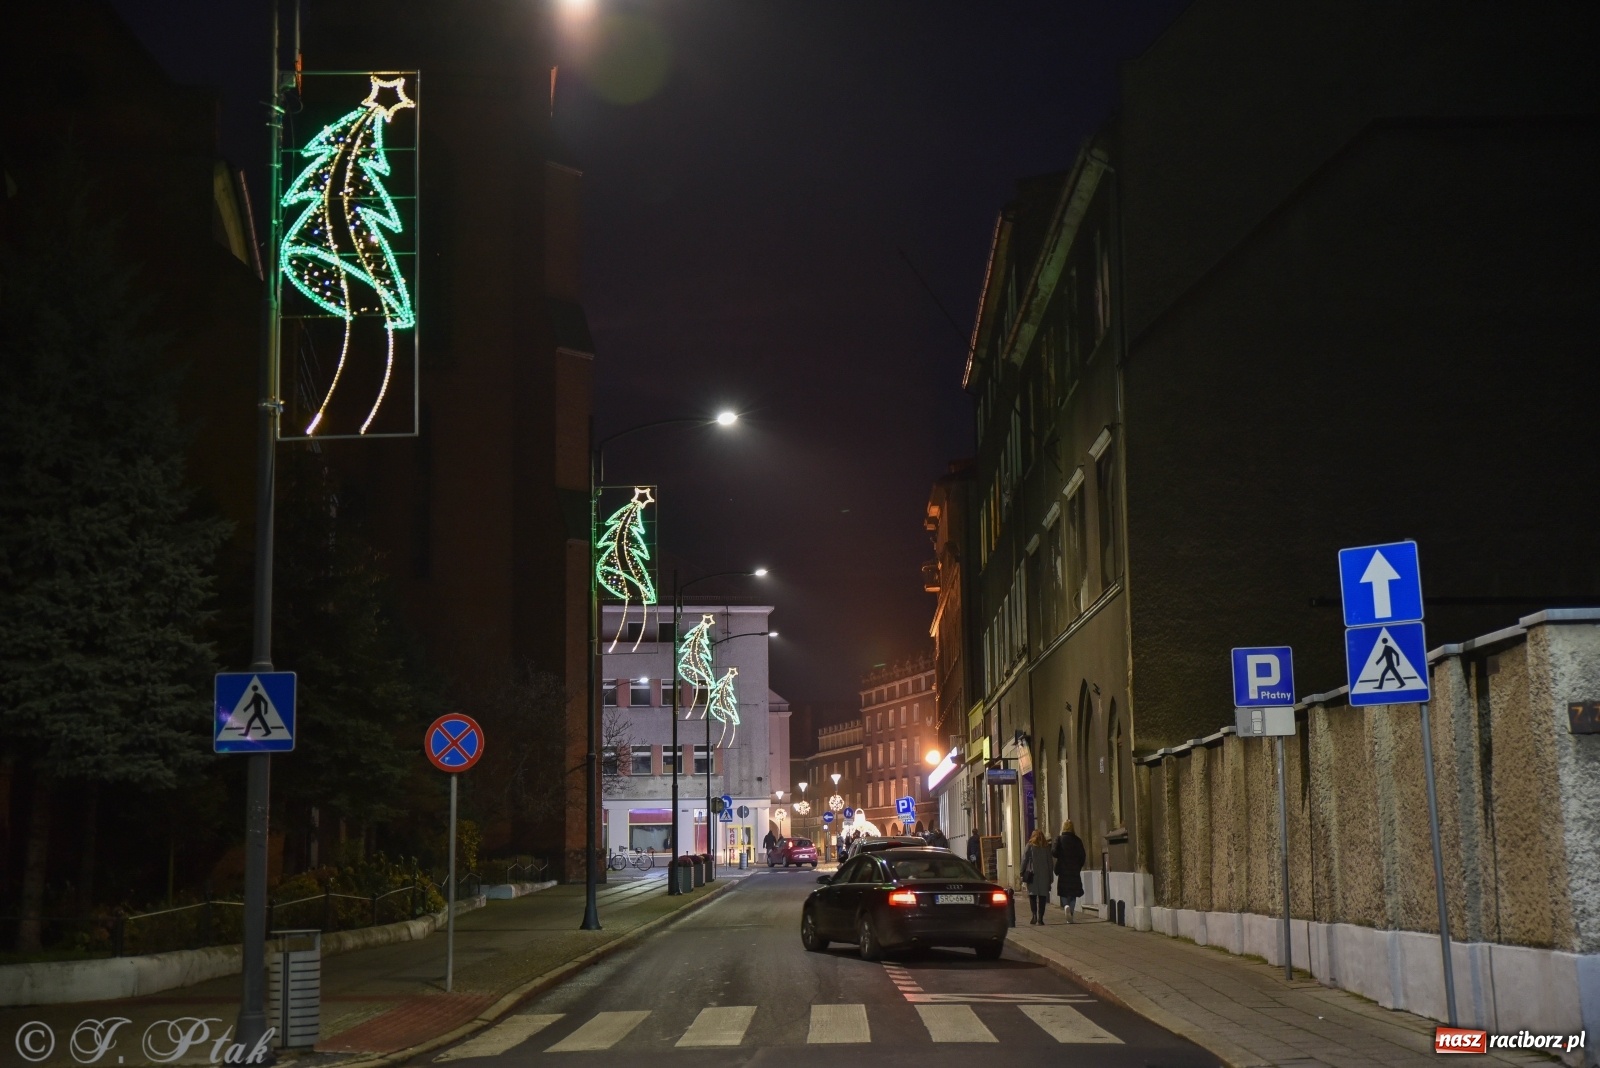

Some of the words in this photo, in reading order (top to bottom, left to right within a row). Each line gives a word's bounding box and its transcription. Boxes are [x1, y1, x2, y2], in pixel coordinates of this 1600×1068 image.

[1247, 654, 1280, 699] P
[1261, 691, 1291, 700] Płatny
[899, 800, 908, 812] P
